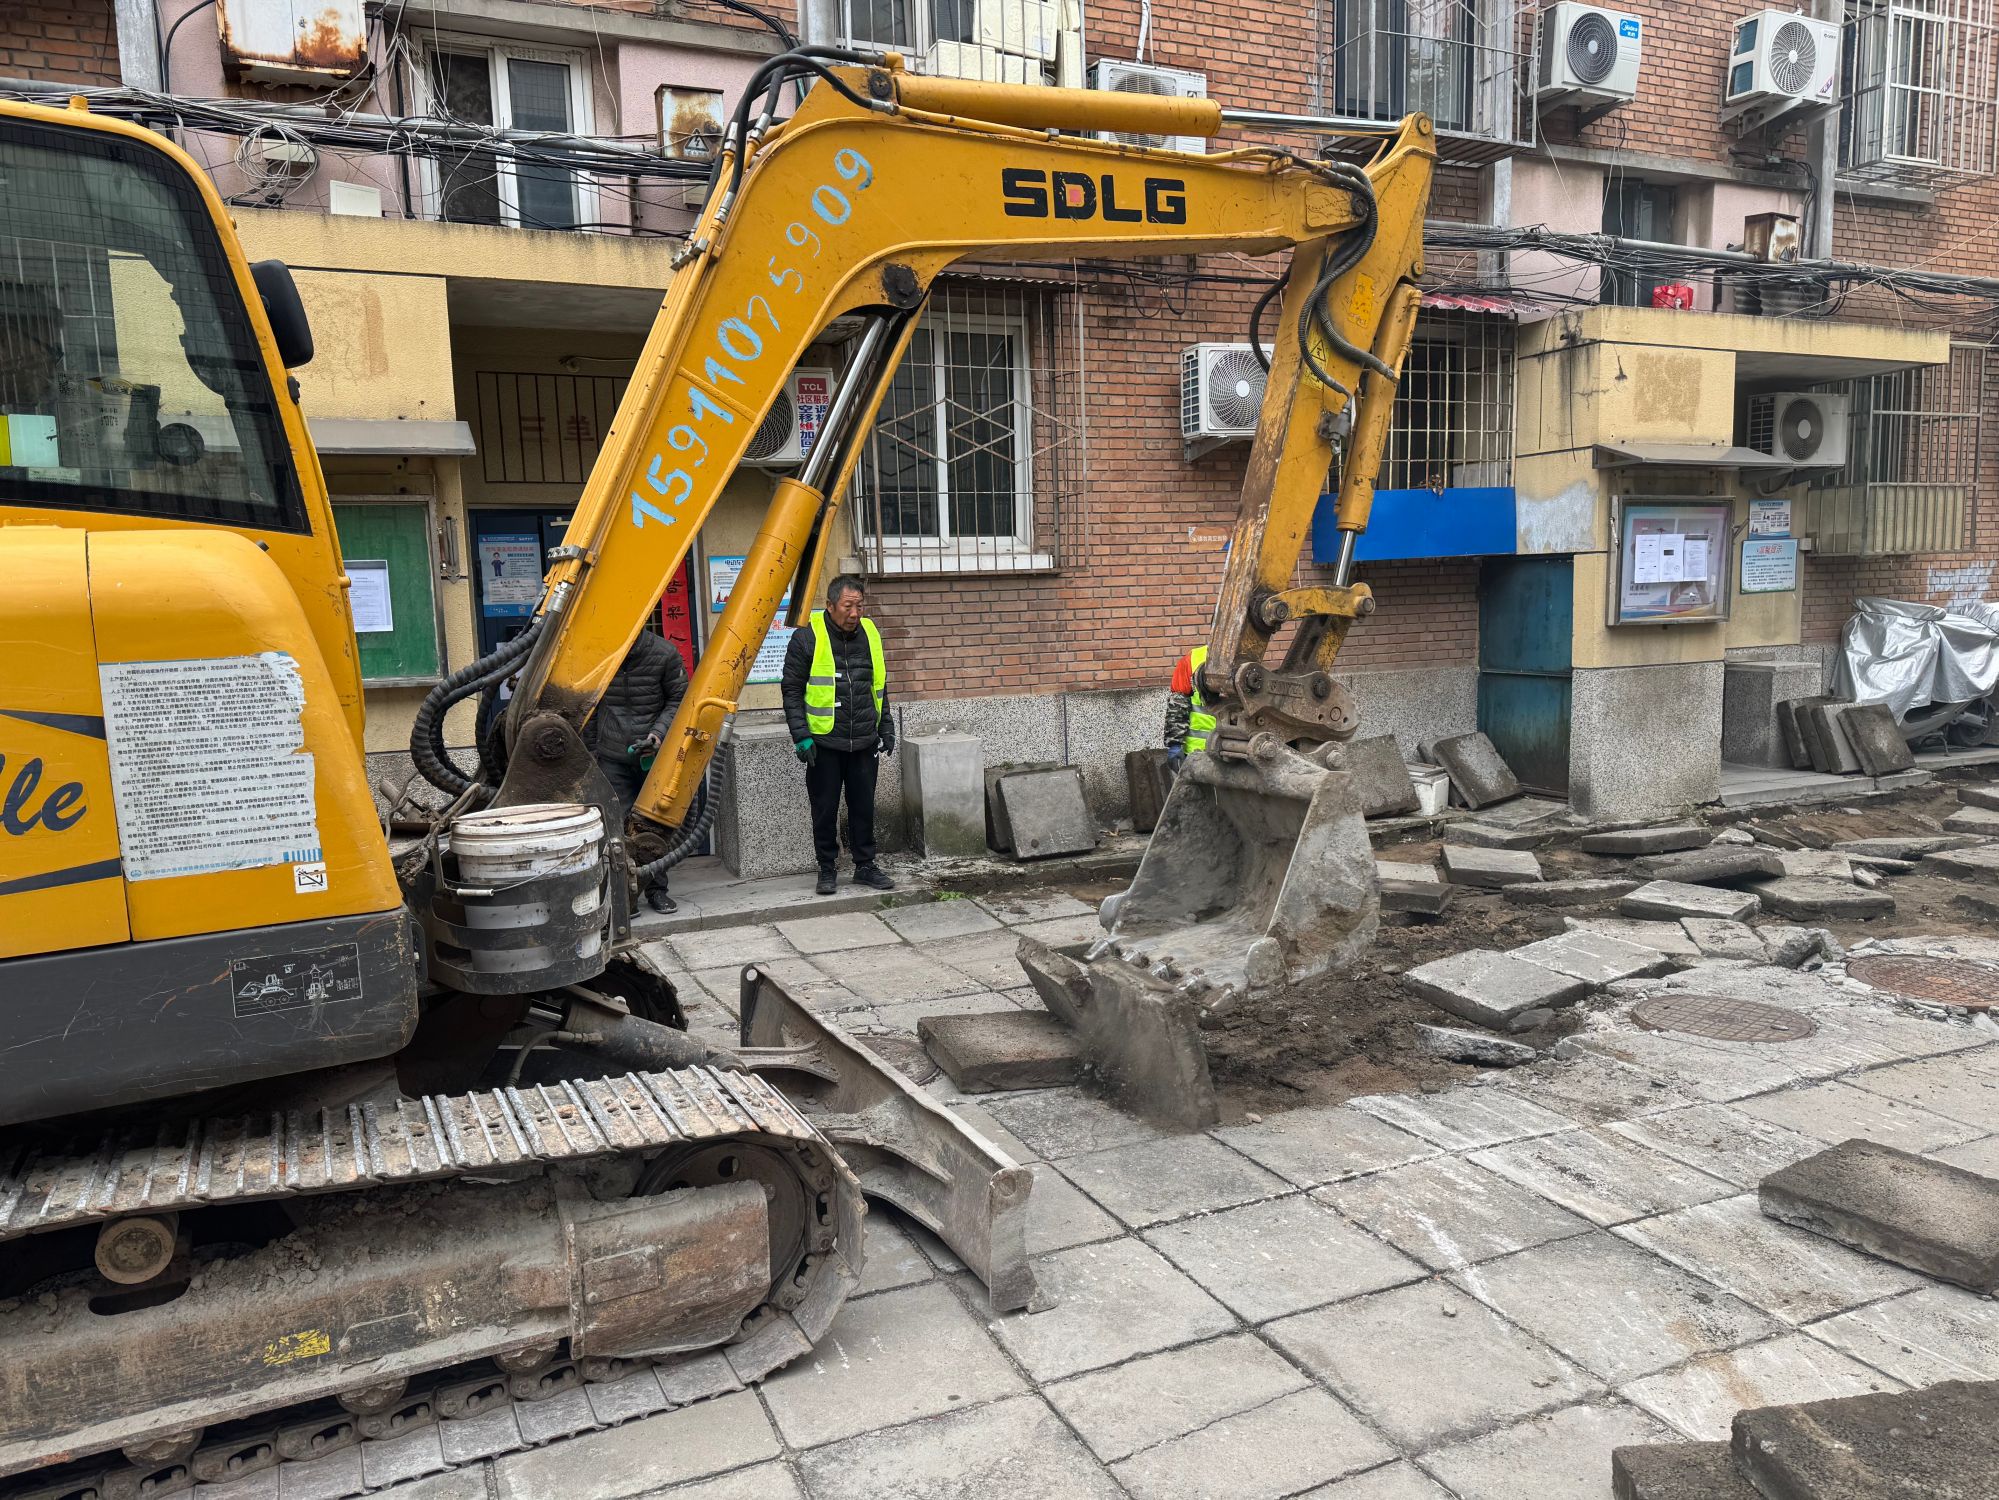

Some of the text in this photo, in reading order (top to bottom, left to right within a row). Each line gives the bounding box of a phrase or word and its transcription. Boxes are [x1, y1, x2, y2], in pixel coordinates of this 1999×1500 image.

[1002, 168, 1187, 225] SDLG
[631, 148, 874, 530] 15911075909
[797, 395, 830, 404] 社区服务
[802, 383, 823, 391] TCL
[0, 753, 87, 836] le
